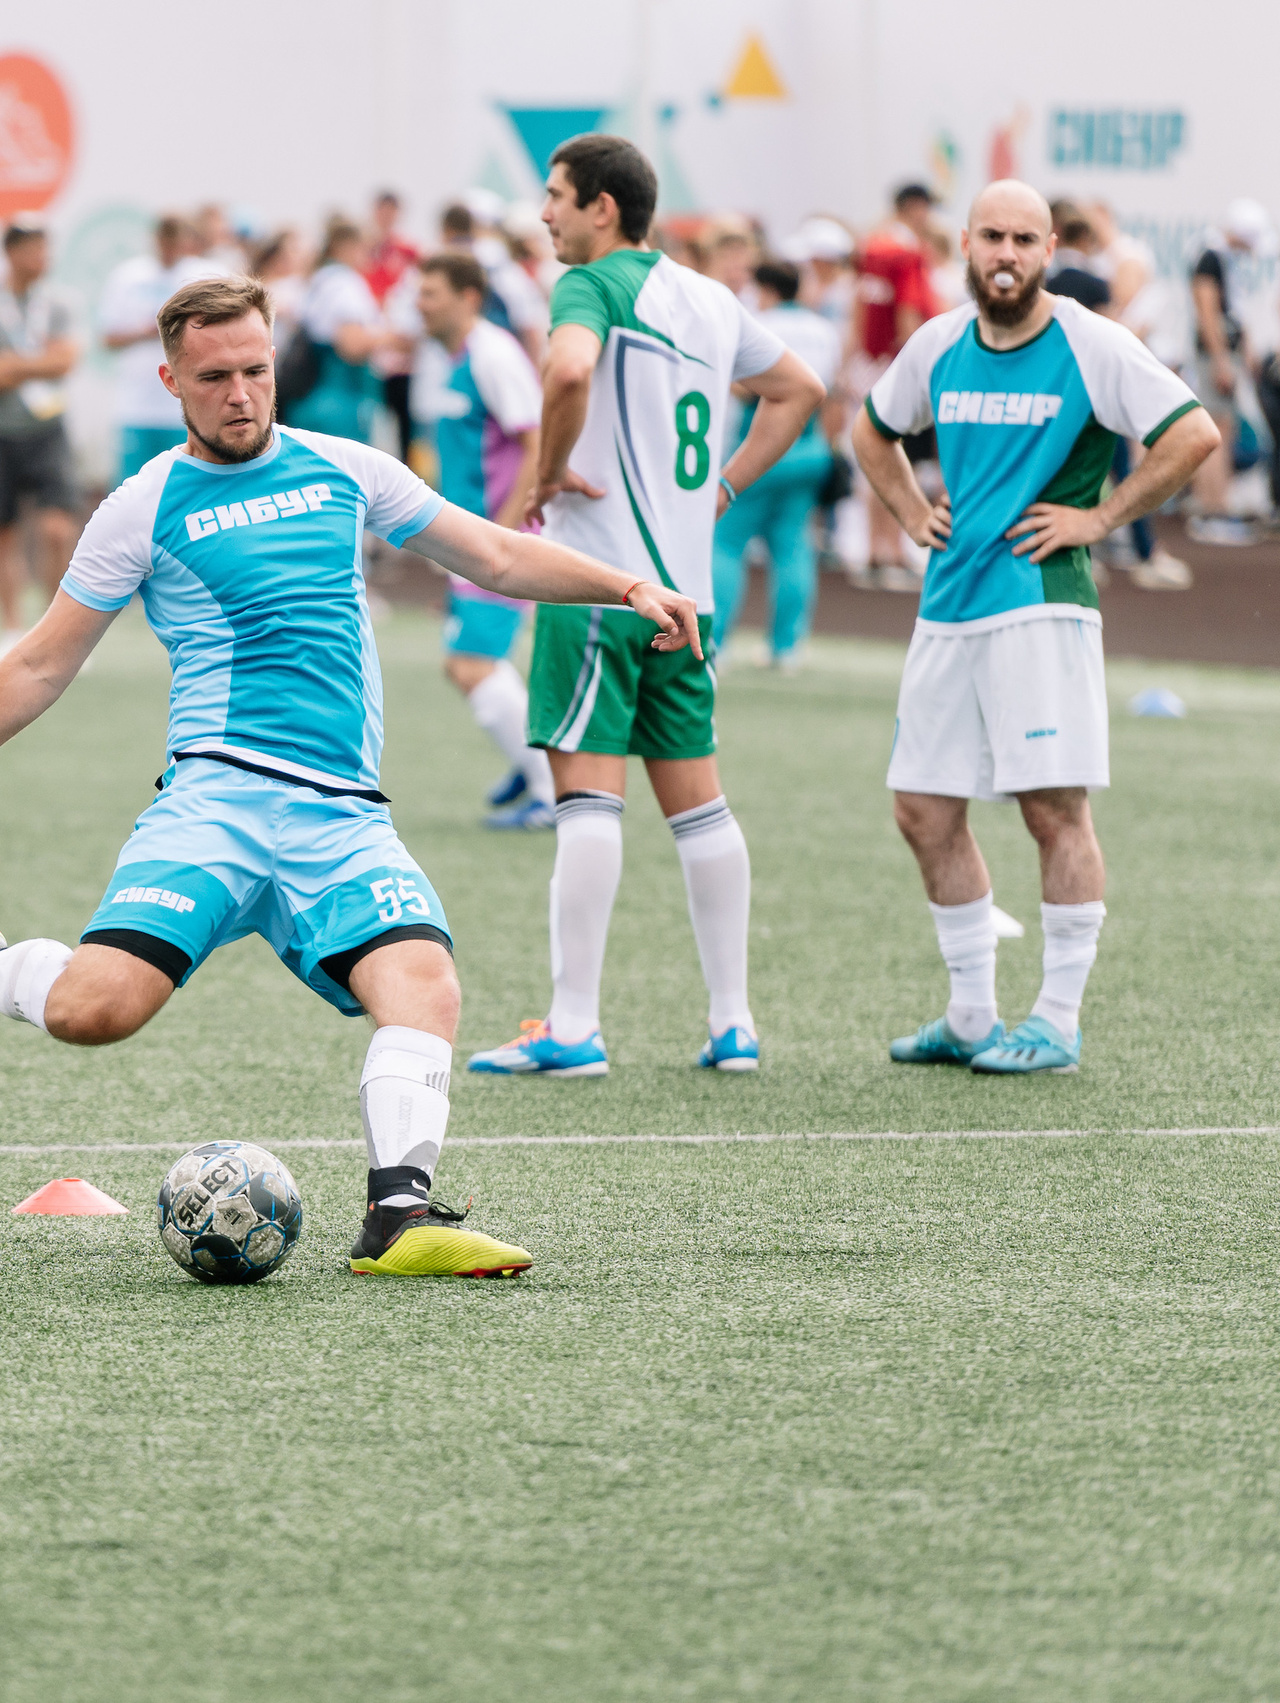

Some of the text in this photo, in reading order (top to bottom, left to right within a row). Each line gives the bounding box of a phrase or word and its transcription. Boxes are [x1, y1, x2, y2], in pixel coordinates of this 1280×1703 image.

[937, 390, 1063, 427] СИБУР
[674, 390, 710, 491] 8
[185, 483, 332, 542] СИБУР
[111, 886, 196, 914] СИБУР
[369, 877, 431, 923] 55
[178, 1160, 239, 1228] SELECT
